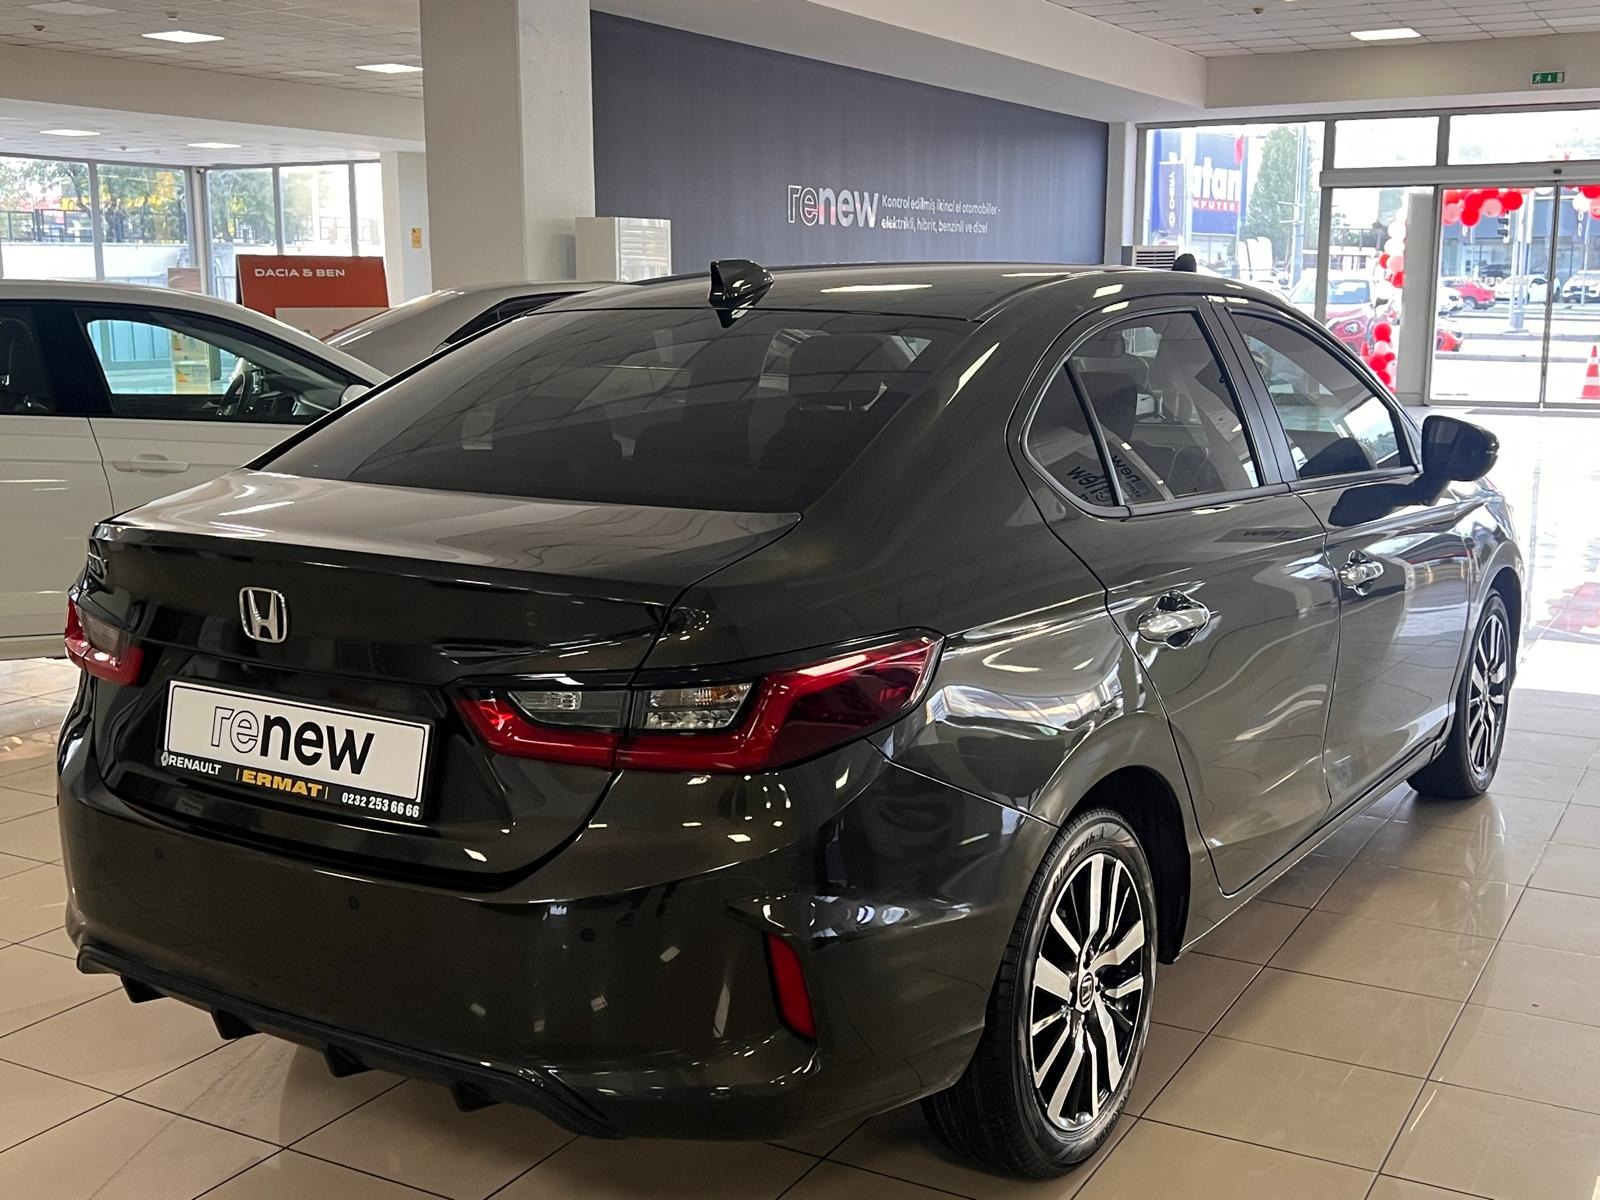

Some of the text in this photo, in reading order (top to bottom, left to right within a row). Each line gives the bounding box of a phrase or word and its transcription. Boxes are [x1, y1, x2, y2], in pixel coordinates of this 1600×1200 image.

[788, 184, 879, 228] renew
[881, 194, 910, 209] Kontrol
[962, 202, 997, 215] otomobiller
[973, 221, 988, 233] dizel
[254, 268, 345, 277] DACIA & BEN
[210, 705, 375, 775] renew
[168, 754, 420, 818] RENAULT ERMAT 0232 253 66 66
